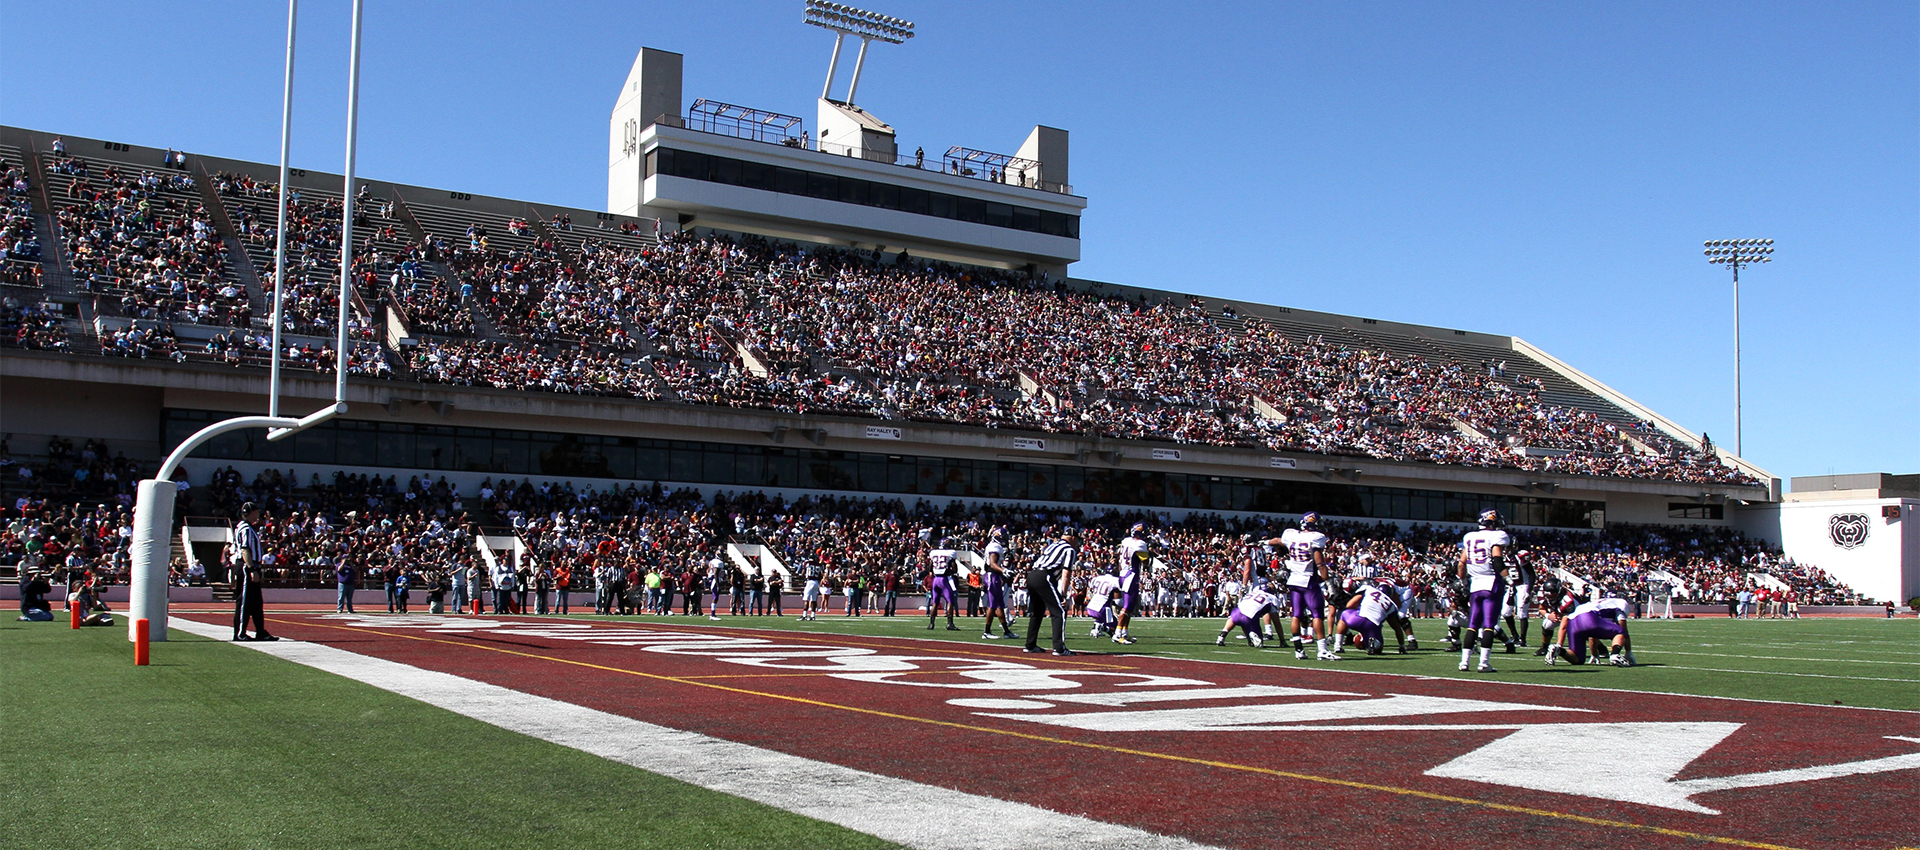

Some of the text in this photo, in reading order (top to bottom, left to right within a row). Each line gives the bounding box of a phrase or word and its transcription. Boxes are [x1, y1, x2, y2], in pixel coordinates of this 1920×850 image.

[104, 141, 129, 152] BBB
[290, 169, 306, 177] CC
[450, 191, 472, 201] DDD
[596, 212, 615, 221] EEE
[1466, 539, 1488, 565] 15
[1370, 591, 1392, 611] 43
